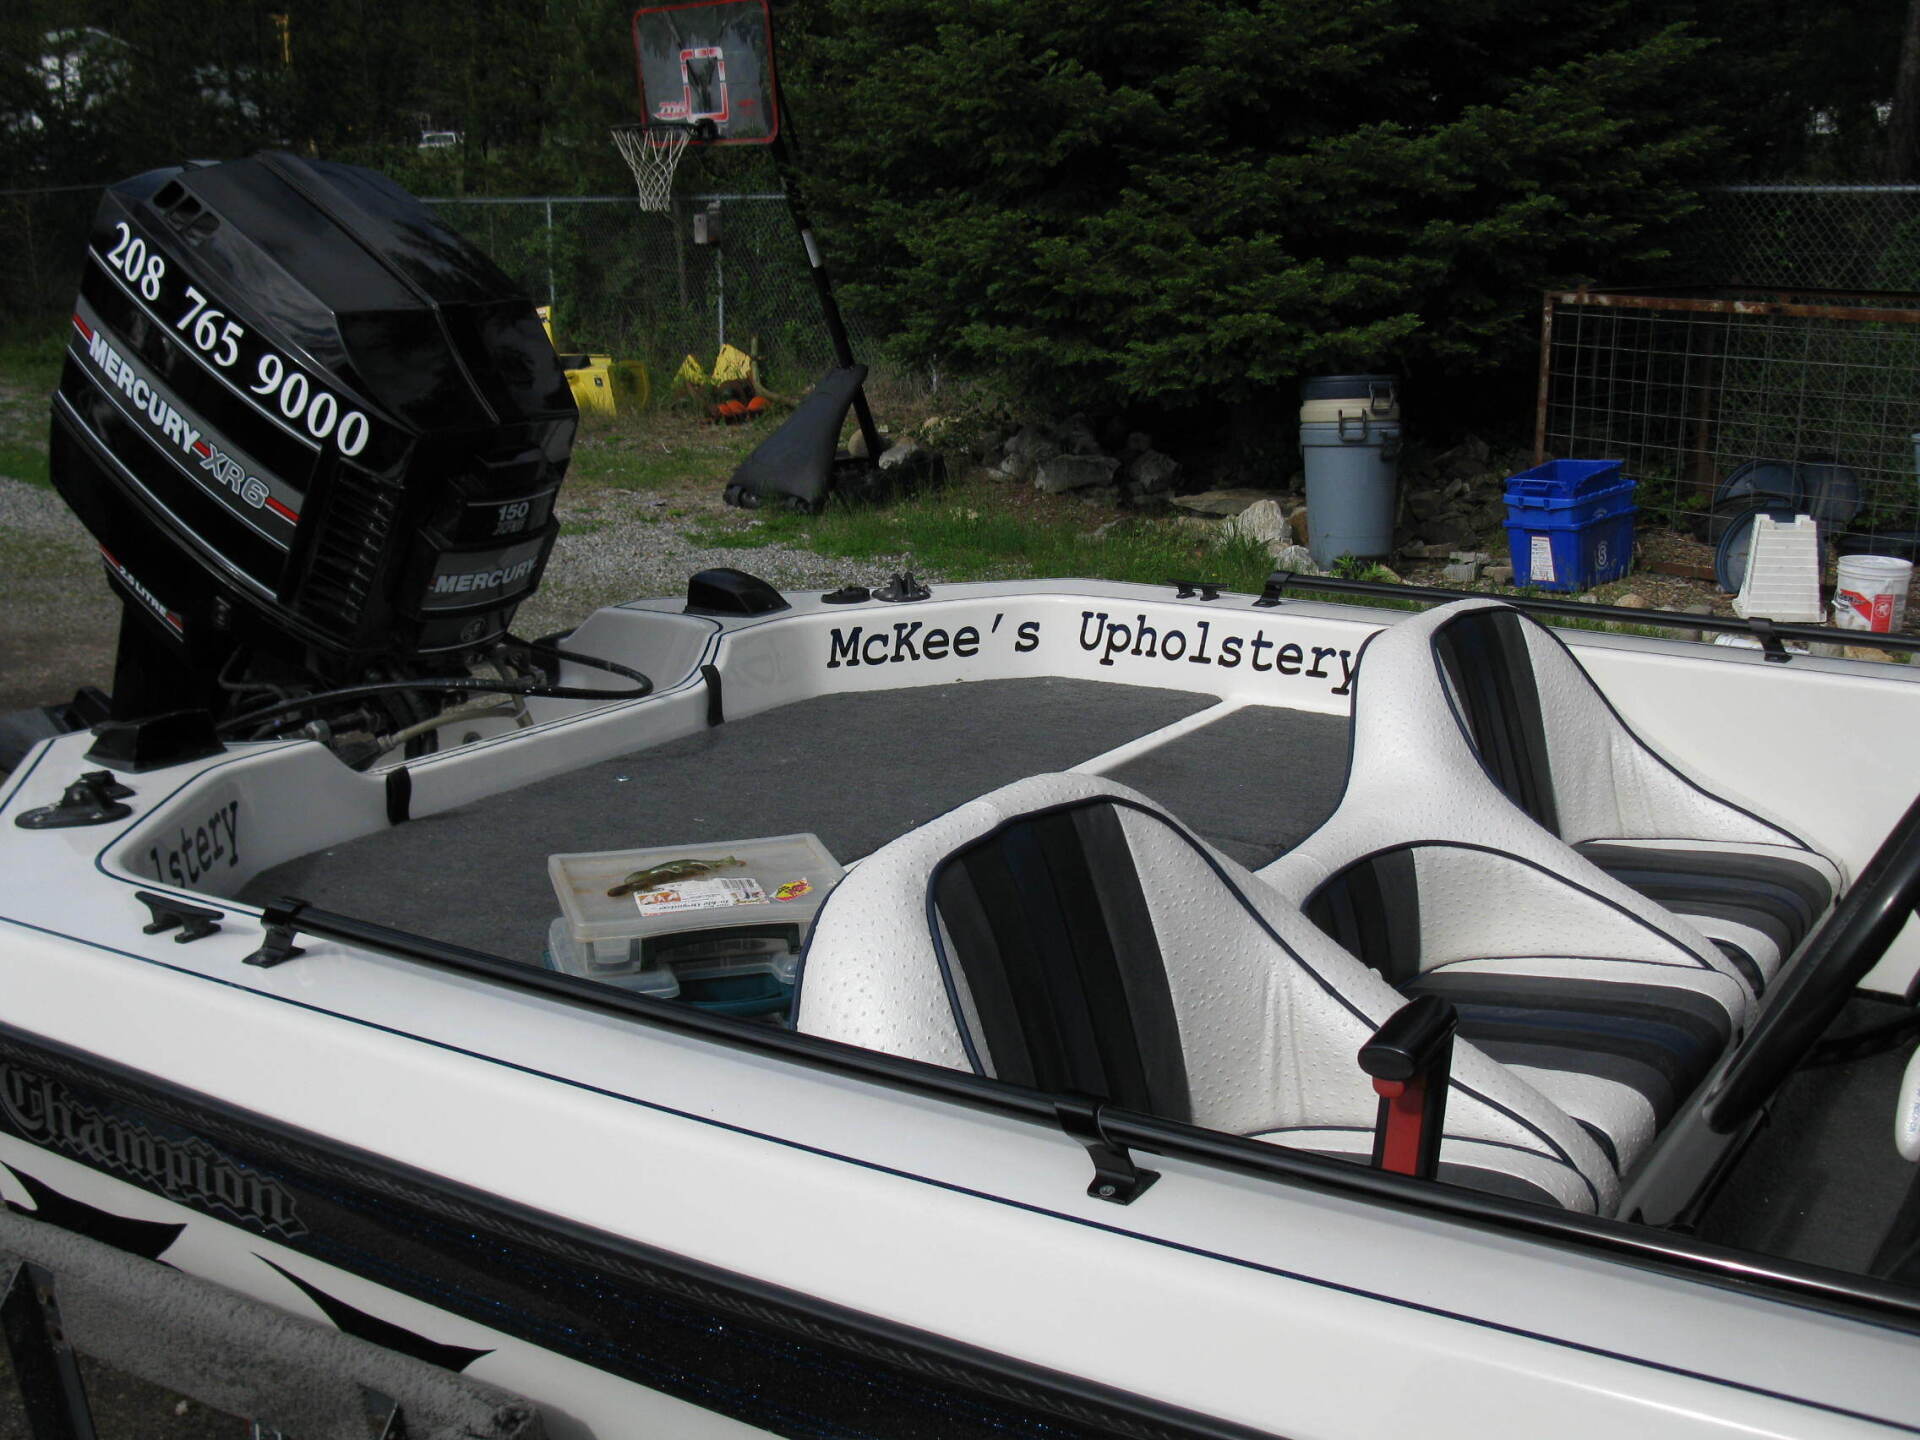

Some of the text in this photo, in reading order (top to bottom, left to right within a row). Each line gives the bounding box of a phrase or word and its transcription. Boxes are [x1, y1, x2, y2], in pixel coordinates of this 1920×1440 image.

[107, 221, 369, 457] 208 765 9000
[89, 329, 270, 509] MERCURY XR6
[498, 501, 530, 521] 150
[434, 559, 536, 593] MERCURY
[826, 613, 1041, 669] McKee's
[1078, 610, 1358, 697] Upholstery
[0, 1062, 300, 1230] Champion
